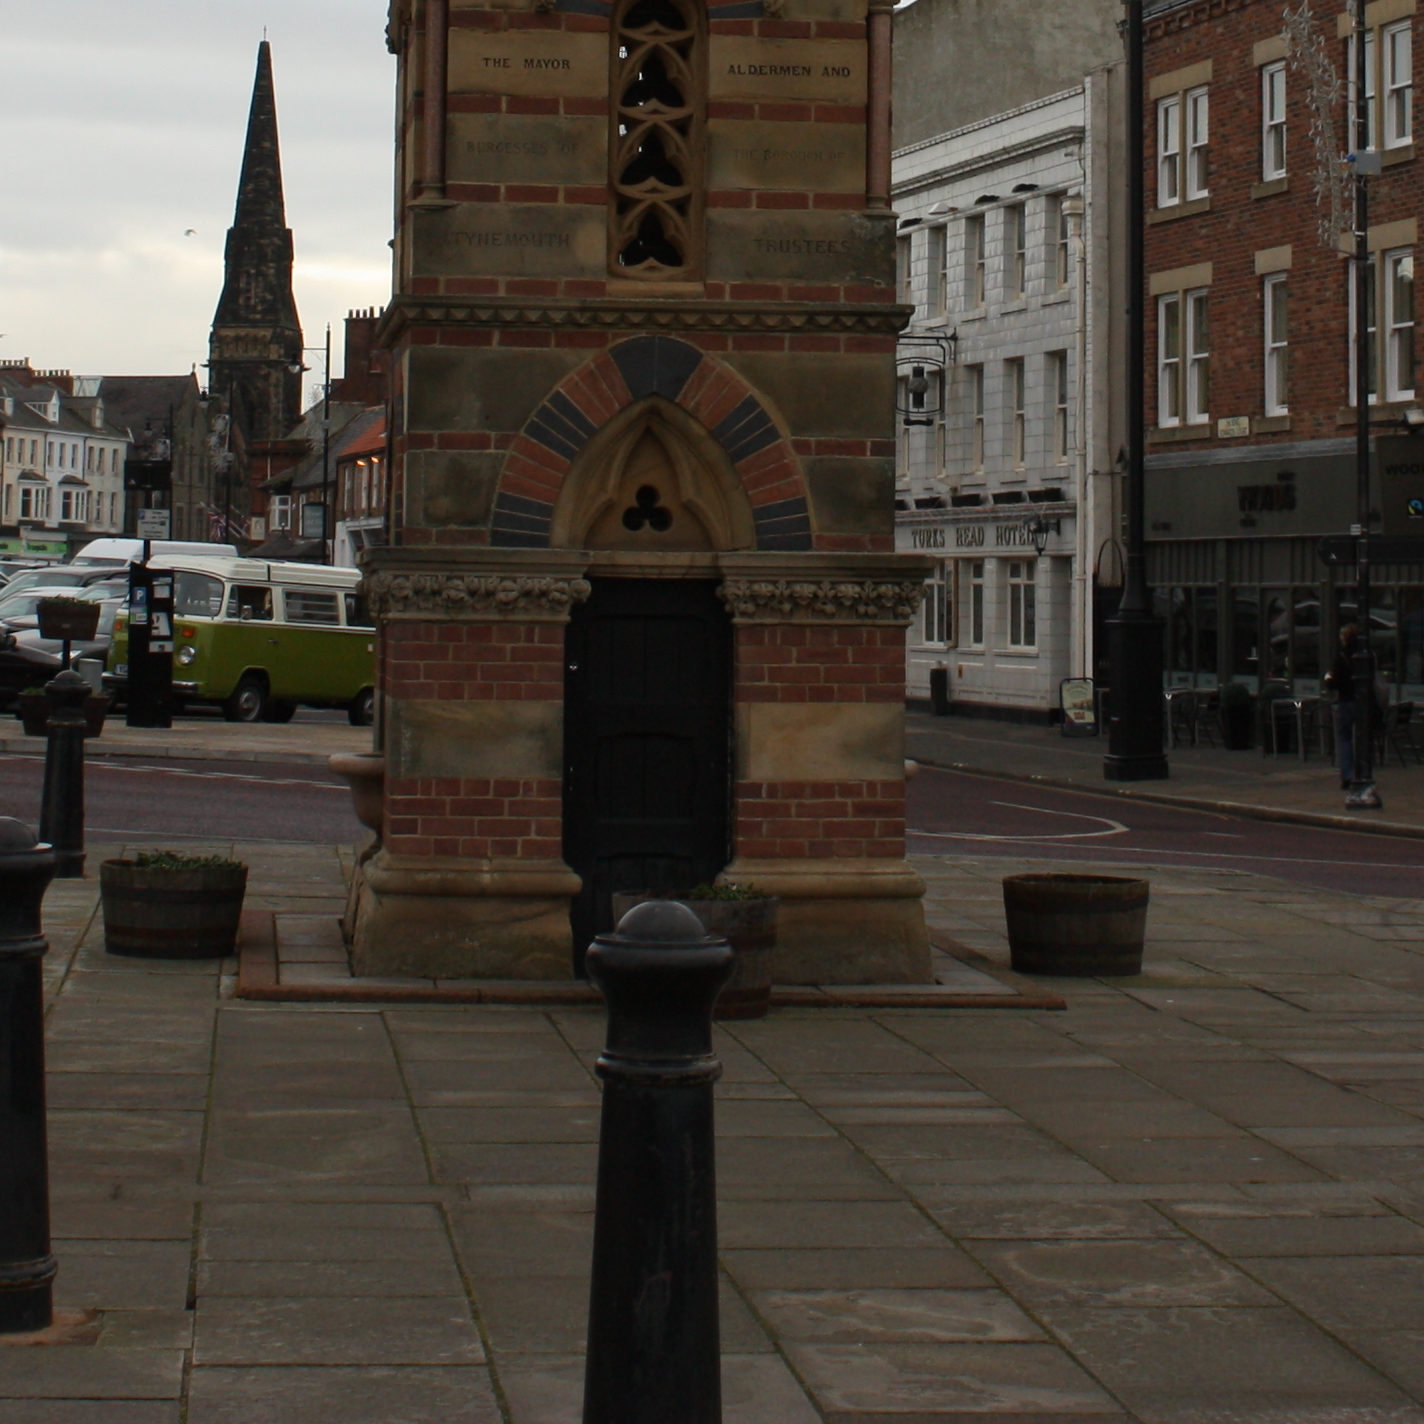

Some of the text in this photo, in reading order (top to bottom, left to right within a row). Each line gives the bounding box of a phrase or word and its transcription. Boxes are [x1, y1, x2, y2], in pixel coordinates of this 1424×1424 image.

[483, 57, 571, 70] THE MAYOR
[727, 64, 851, 78] ALDERMEN AND
[467, 141, 549, 156] BURGESSES
[734, 149, 760, 161] THE
[451, 231, 569, 248] TYNEMOUTH
[753, 238, 850, 254] TRUSTEES
[911, 528, 946, 549] TURKS
[956, 525, 985, 547] HEAD
